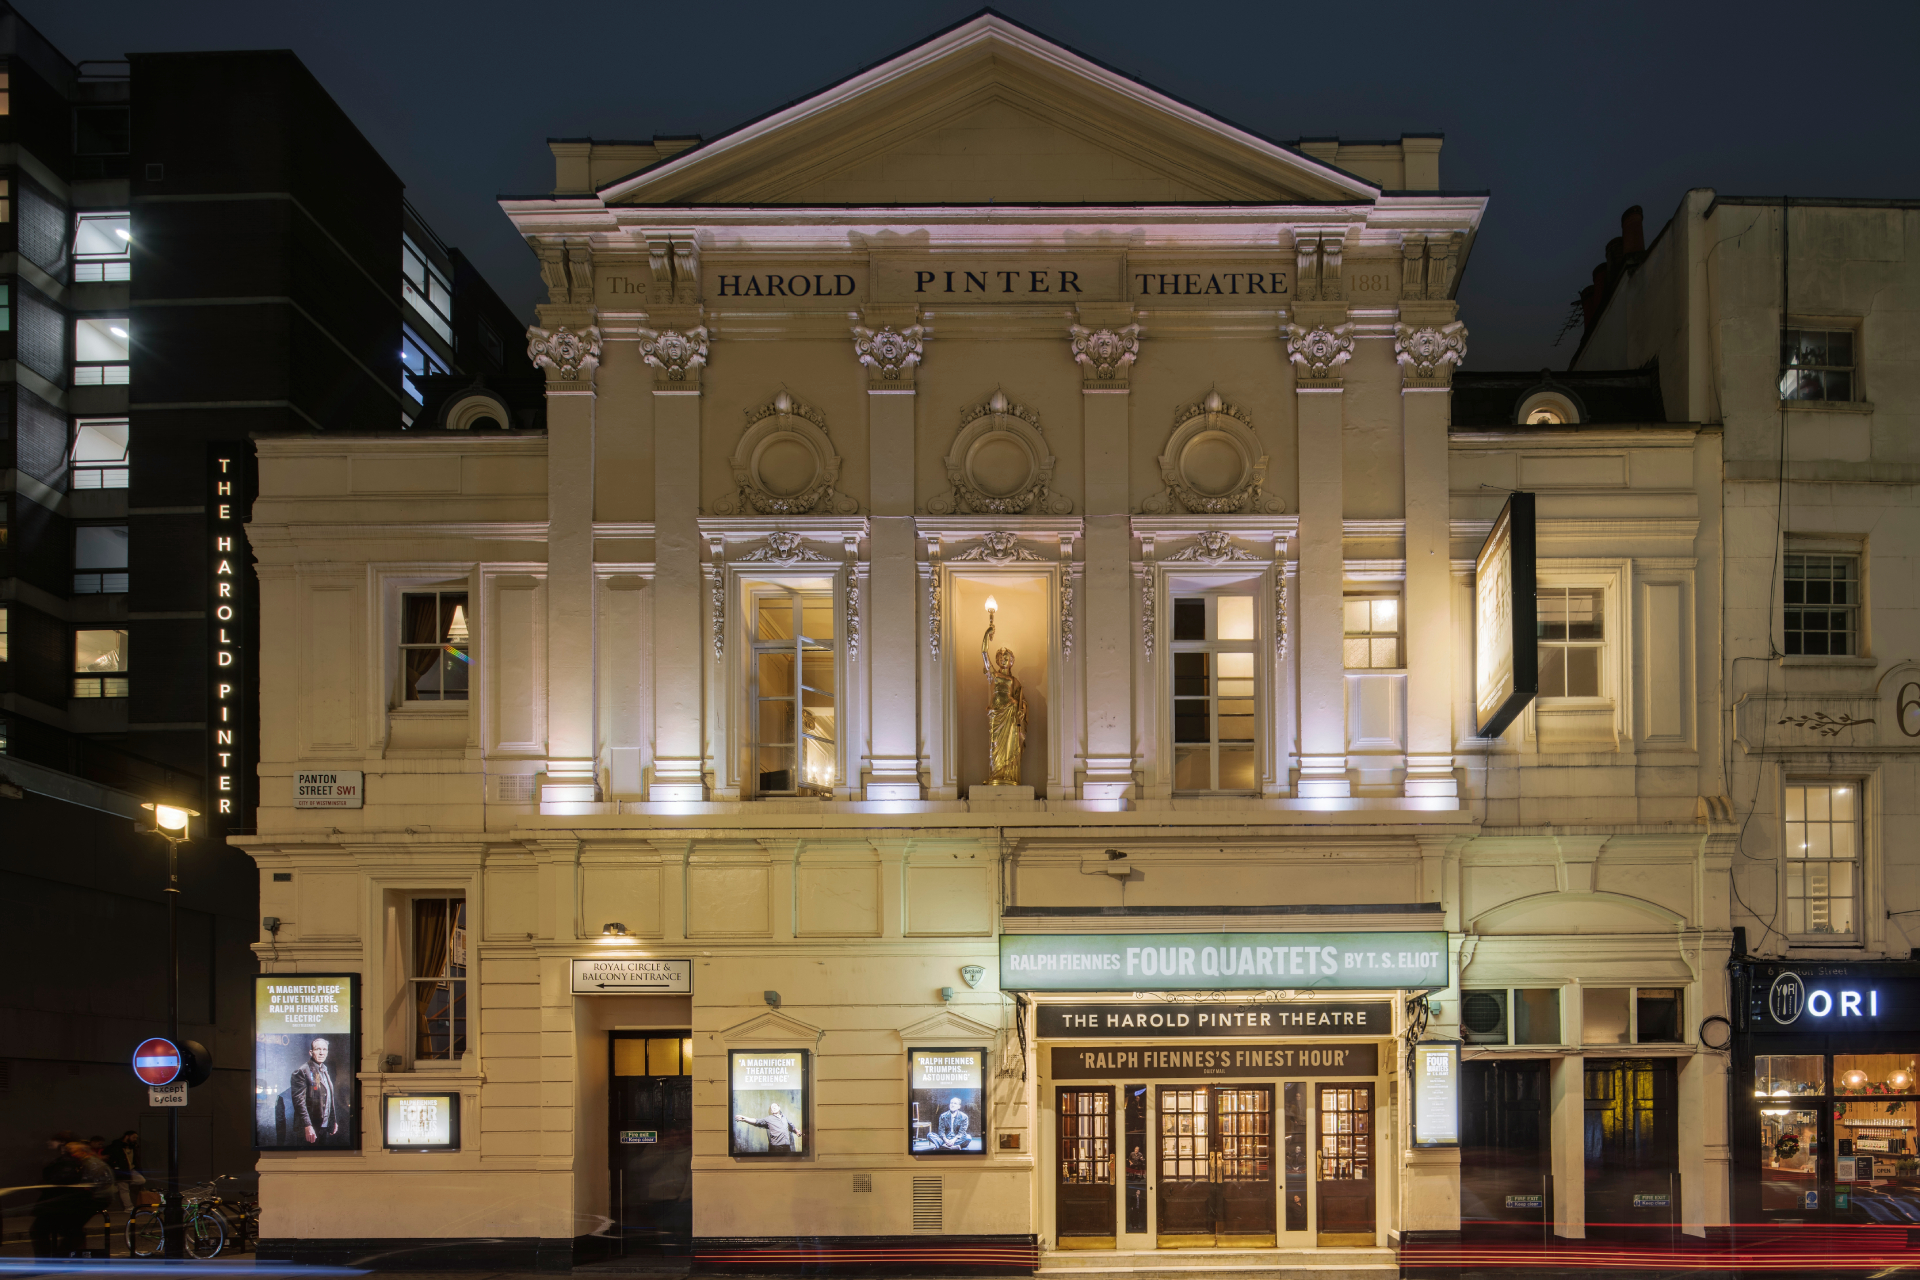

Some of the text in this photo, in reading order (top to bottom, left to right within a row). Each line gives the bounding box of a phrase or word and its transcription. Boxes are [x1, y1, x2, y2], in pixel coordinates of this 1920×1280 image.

[606, 270, 1390, 297] The HAROLD PINTER THEATRE 1881
[217, 458, 233, 814] THE HAROLD PINTER
[299, 774, 337, 784] PANTON
[299, 785, 356, 796] STREET SW1
[1010, 946, 1439, 977] RALPH FIENNES FOUR QUARTETS BY T. S. ELIOT
[593, 962, 671, 972] ROYAL CIRCLE &
[1767, 967, 1774, 976] 6
[1818, 966, 1848, 976] Street
[582, 972, 681, 981] BALCONY ENTRANCE
[276, 985, 316, 994] MAGNETIC
[317, 985, 340, 994] PIECE
[271, 995, 337, 1004] OF LIVE THEATRE.
[1807, 989, 1877, 1017] ORI
[269, 1004, 339, 1013] RALPH FIENNES IS
[1062, 1011, 1367, 1028] THE HAROLD PINTER THEATRE
[747, 1058, 796, 1067] MAGNIFICENT
[944, 1057, 975, 1065] FIENNES
[1235, 1050, 1294, 1067] FINEST
[1426, 1056, 1449, 1066] FOUR
[746, 1067, 788, 1075] THEATRICAL
[153, 1085, 184, 1094] Except
[154, 1094, 183, 1104] cycles
